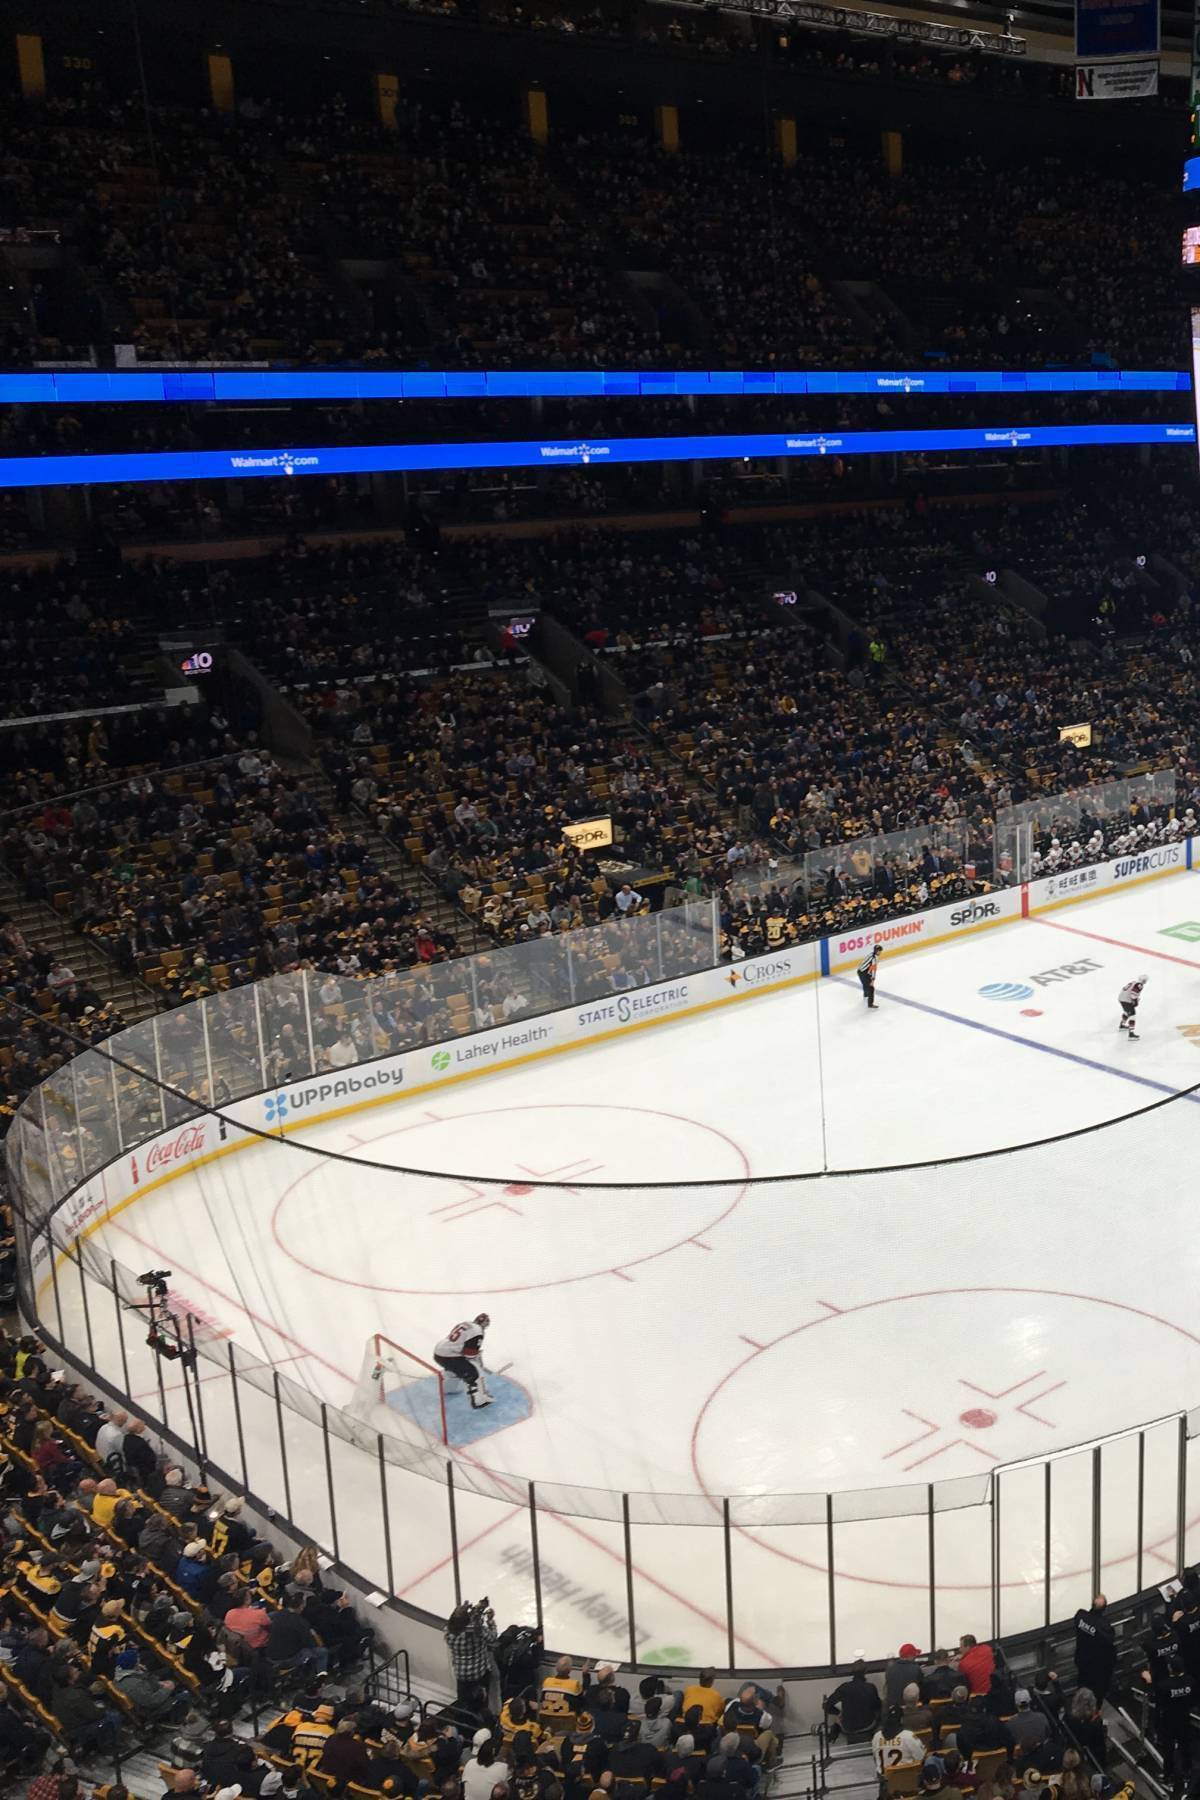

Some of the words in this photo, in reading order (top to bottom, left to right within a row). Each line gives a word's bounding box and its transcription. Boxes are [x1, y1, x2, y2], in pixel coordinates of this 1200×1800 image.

[541, 445, 579, 458] Walmart
[786, 438, 817, 449] Walmart
[231, 455, 279, 469] Walmart
[190, 650, 214, 669] 10
[1113, 847, 1180, 879] SUPERCUTS
[839, 936, 865, 954] BOS
[1029, 957, 1105, 987] AT&T
[578, 1008, 615, 1026] STATE
[632, 985, 689, 1011] ELECTRIC
[456, 1041, 499, 1063] Lahey
[502, 1026, 548, 1050] Health
[289, 1067, 404, 1109] UPPAbaby
